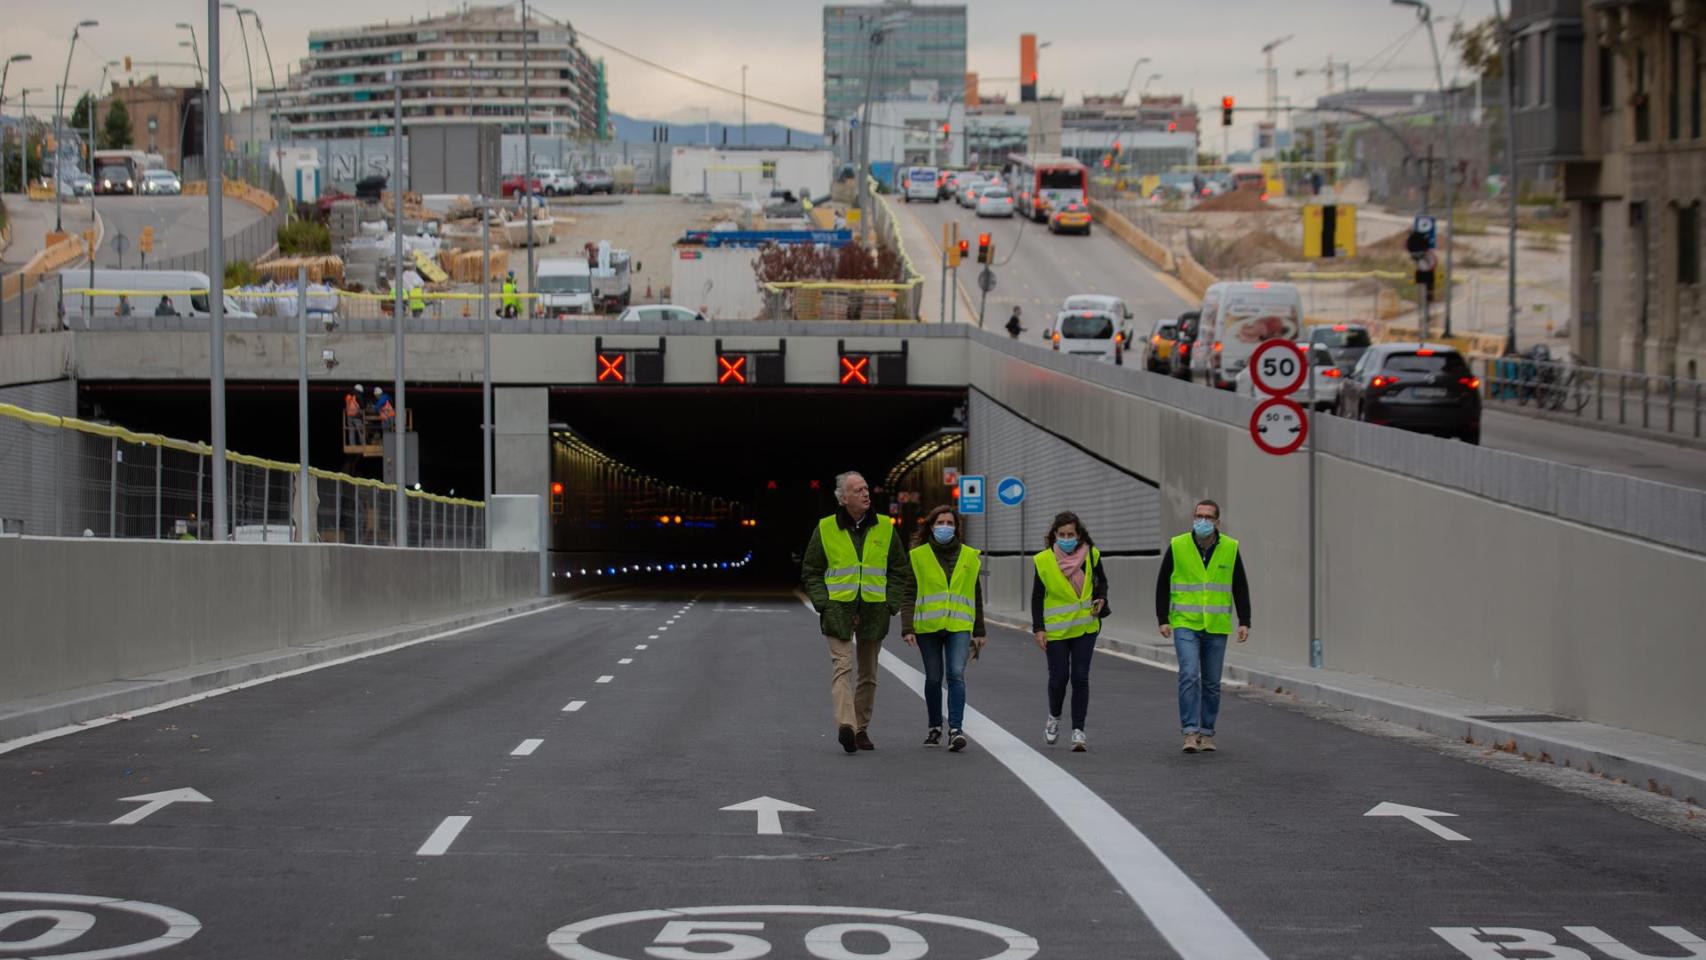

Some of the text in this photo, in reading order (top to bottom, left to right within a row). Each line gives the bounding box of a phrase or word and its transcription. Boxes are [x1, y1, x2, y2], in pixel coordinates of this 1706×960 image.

[1263, 358, 1295, 377] 50
[1265, 412, 1293, 422] 50 m
[643, 921, 930, 960] 50
